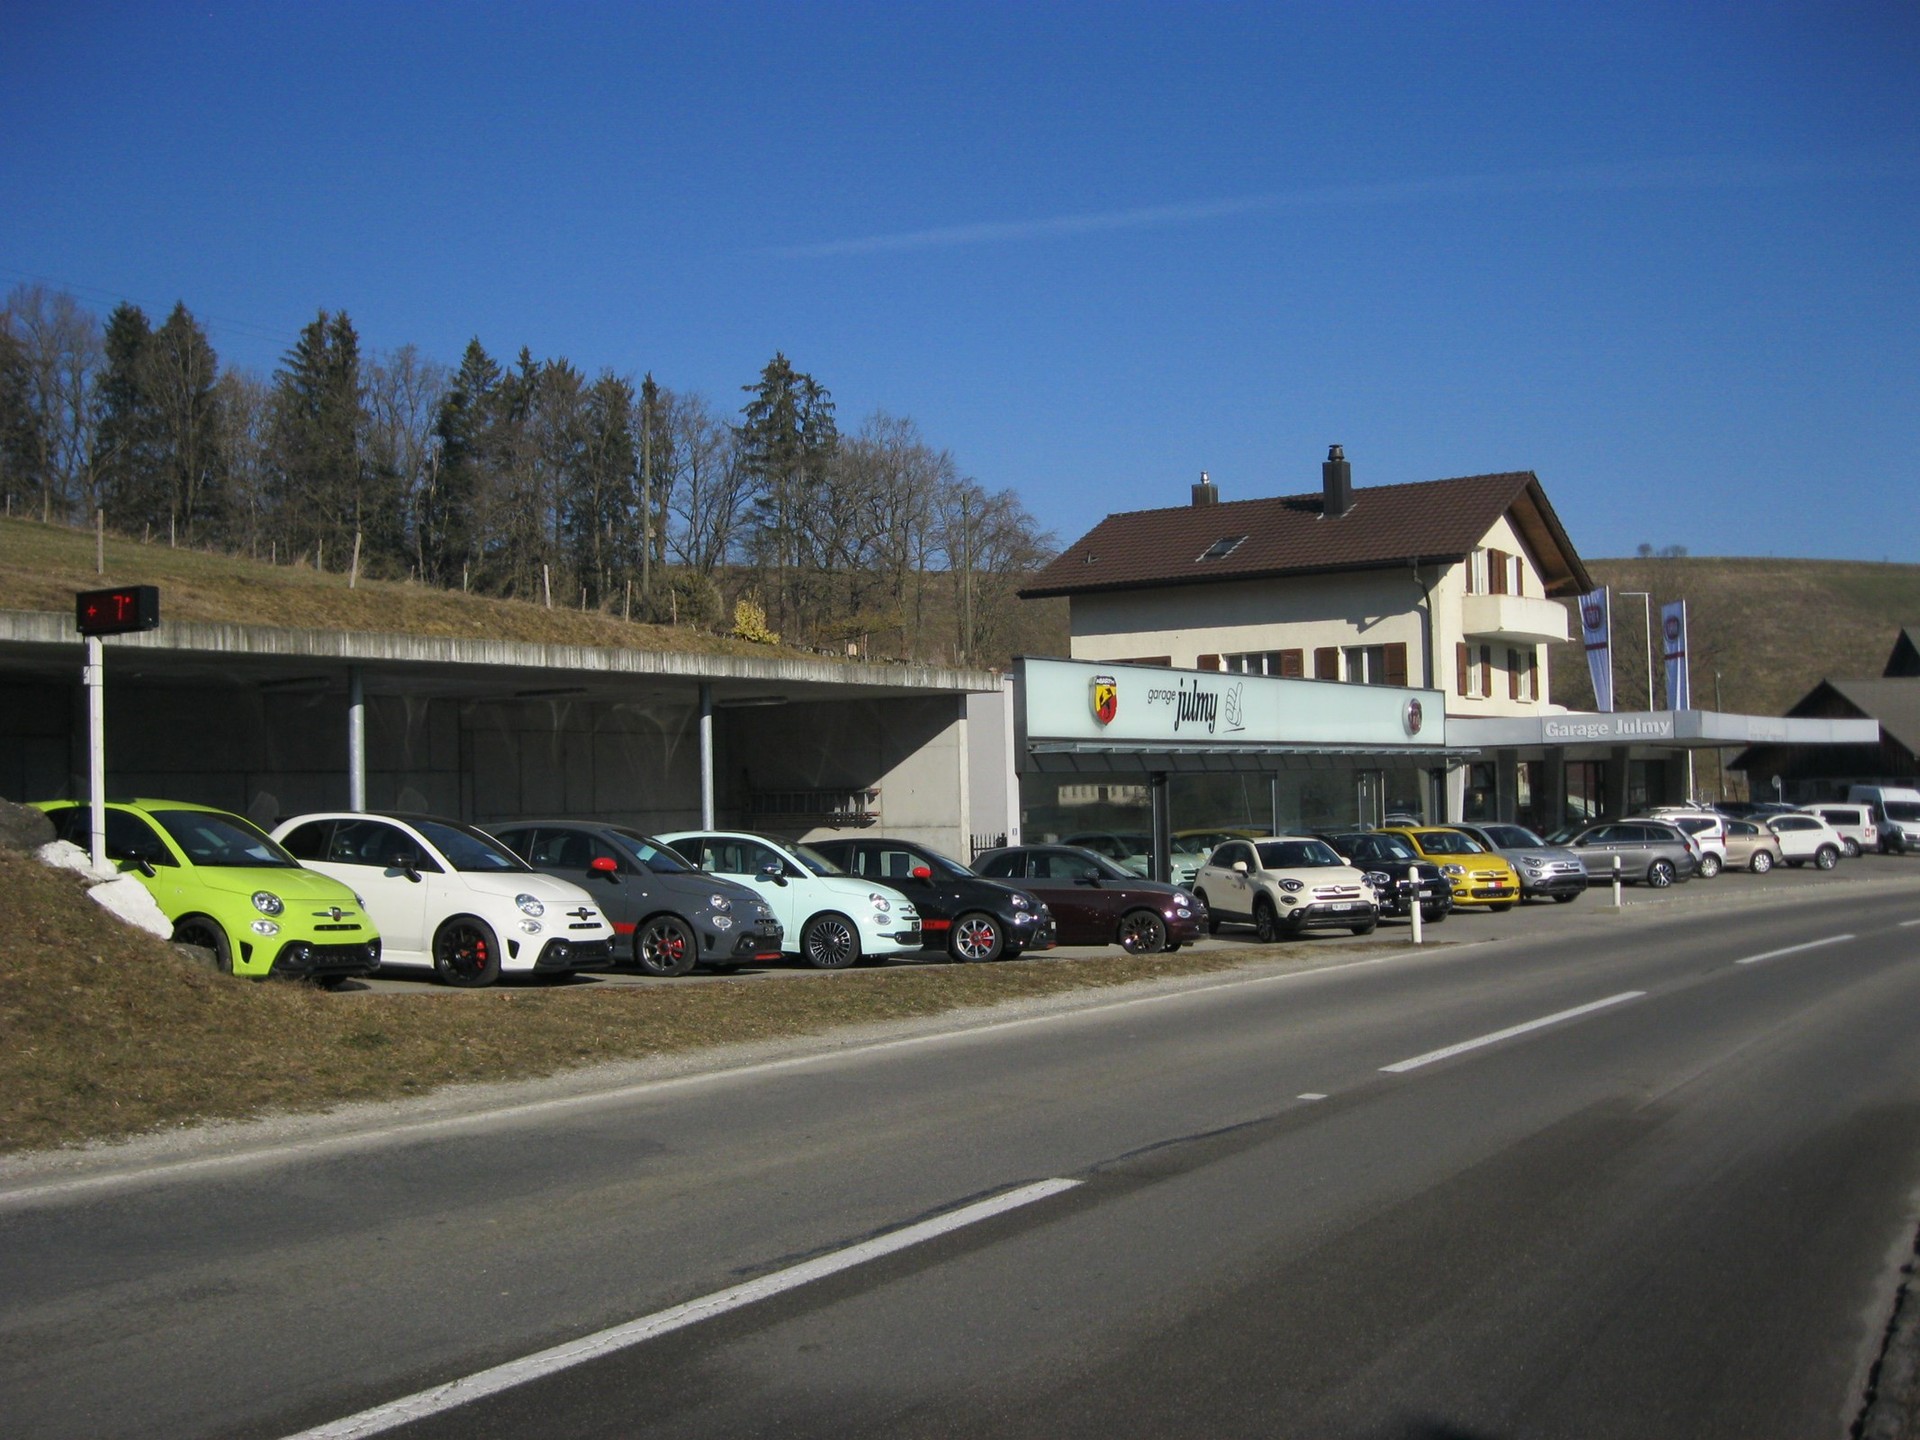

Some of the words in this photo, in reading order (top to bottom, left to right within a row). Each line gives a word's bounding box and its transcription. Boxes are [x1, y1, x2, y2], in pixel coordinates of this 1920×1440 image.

[1147, 688, 1177, 705] garage
[1174, 677, 1218, 734] julmy
[1545, 721, 1609, 738] Garage
[1615, 718, 1670, 736] Julmy
